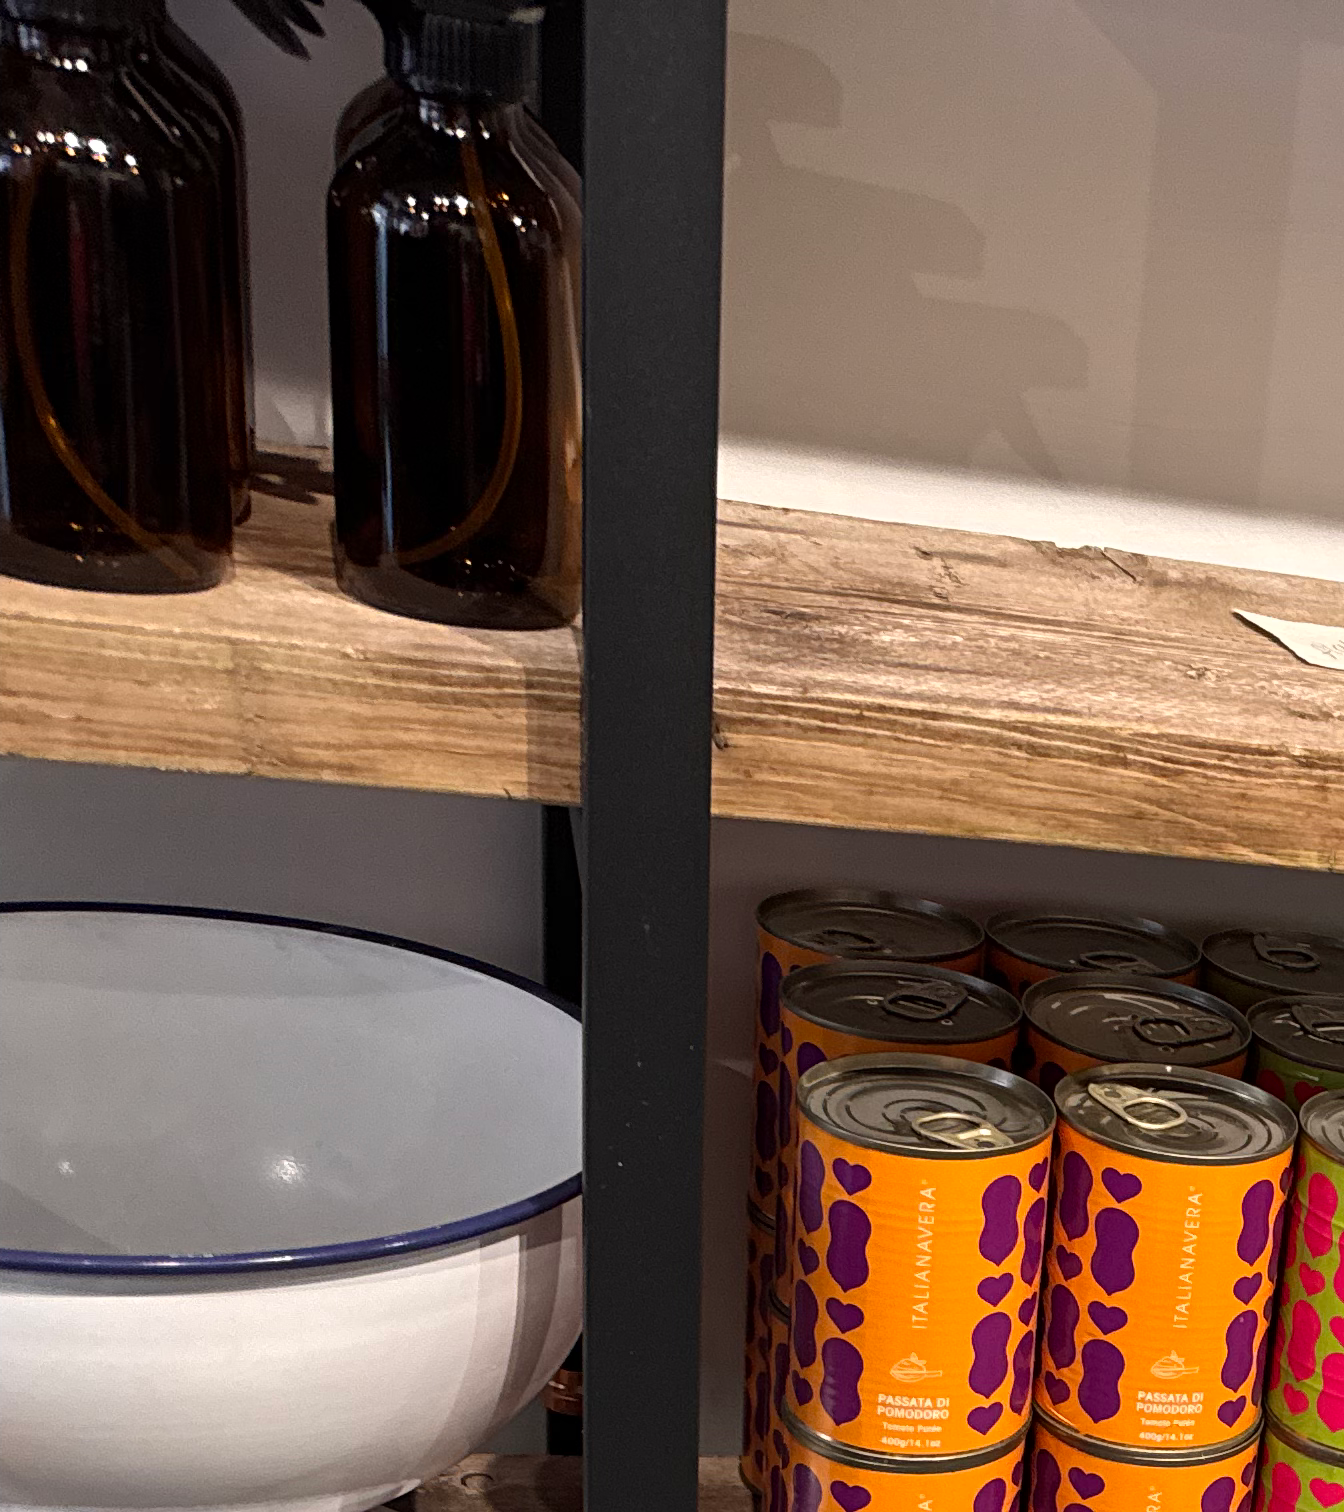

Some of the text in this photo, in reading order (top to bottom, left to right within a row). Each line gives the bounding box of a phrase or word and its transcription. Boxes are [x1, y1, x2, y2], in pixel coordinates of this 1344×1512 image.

[878, 1393, 950, 1408] PASSATA DI
[1137, 1391, 1204, 1403] PASSATA DI
[877, 1406, 949, 1419] POMODORO
[1136, 1402, 1203, 1414] POMODORO
